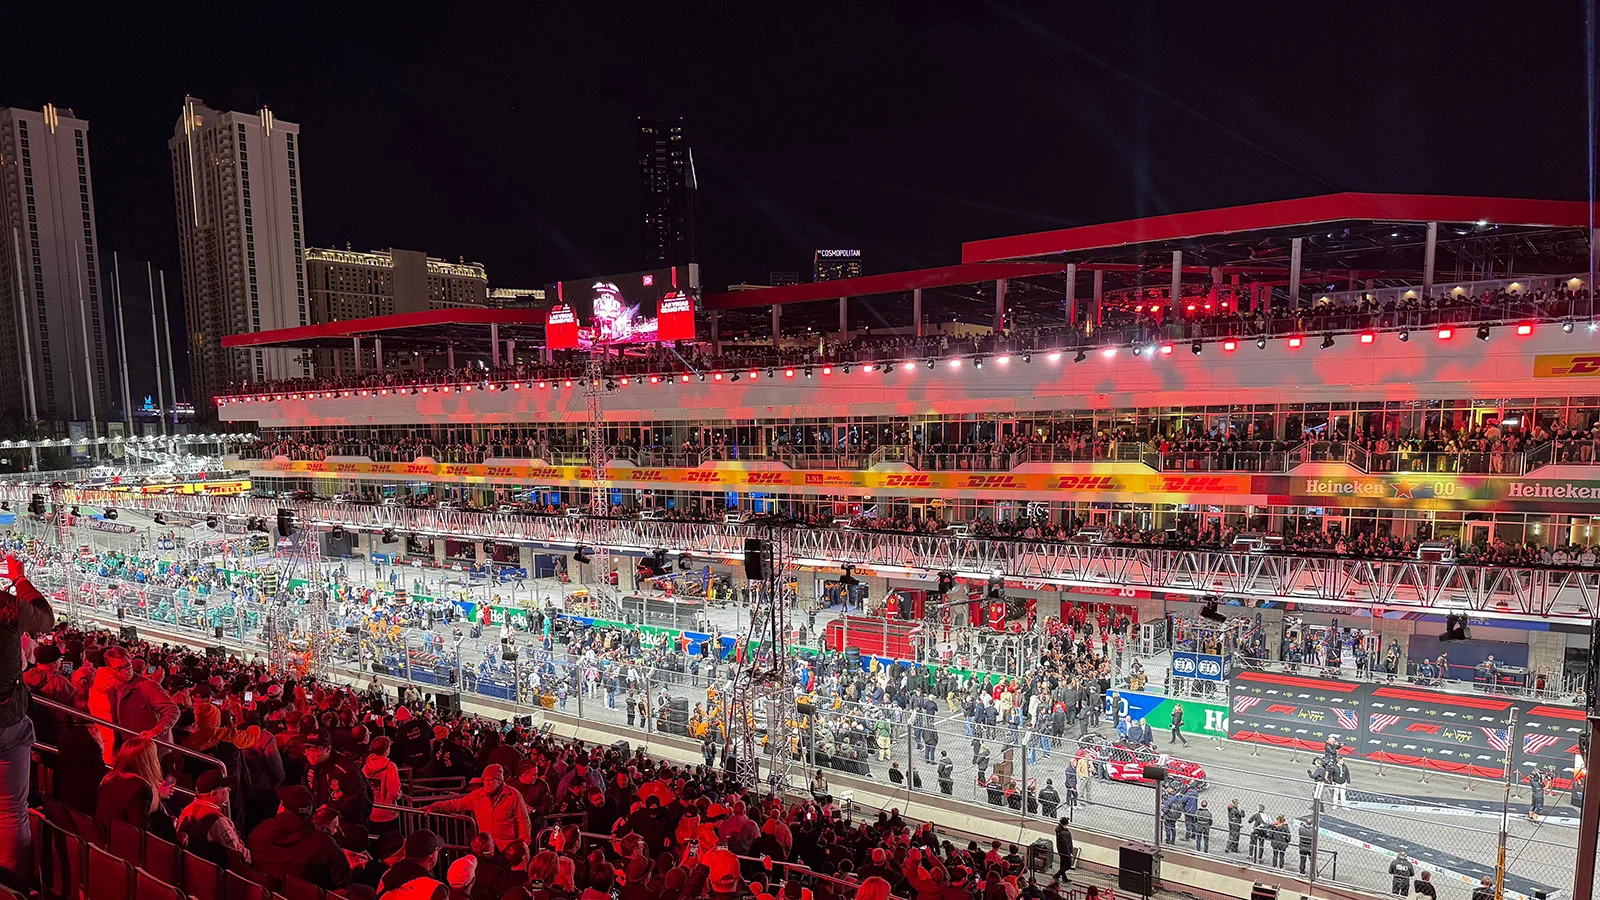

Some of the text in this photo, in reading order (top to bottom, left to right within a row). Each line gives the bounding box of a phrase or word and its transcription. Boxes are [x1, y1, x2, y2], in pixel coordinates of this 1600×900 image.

[821, 249, 860, 257] COSMOPOLITAN
[306, 463, 324, 471] DHL
[337, 464, 356, 472] DHL
[371, 464, 391, 472] DHL
[407, 465, 428, 473] DHL
[446, 466, 468, 475] DHL
[488, 467, 513, 476] DHL
[532, 468, 559, 478] DHL
[631, 470, 662, 480] DHL
[687, 471, 720, 482] DHL
[747, 472, 784, 484] DHL
[886, 474, 932, 487] DHL
[967, 475, 1017, 488] DHL
[1057, 476, 1115, 490] DHL
[1162, 477, 1226, 492] DHL
[1305, 479, 1385, 495] Heineken
